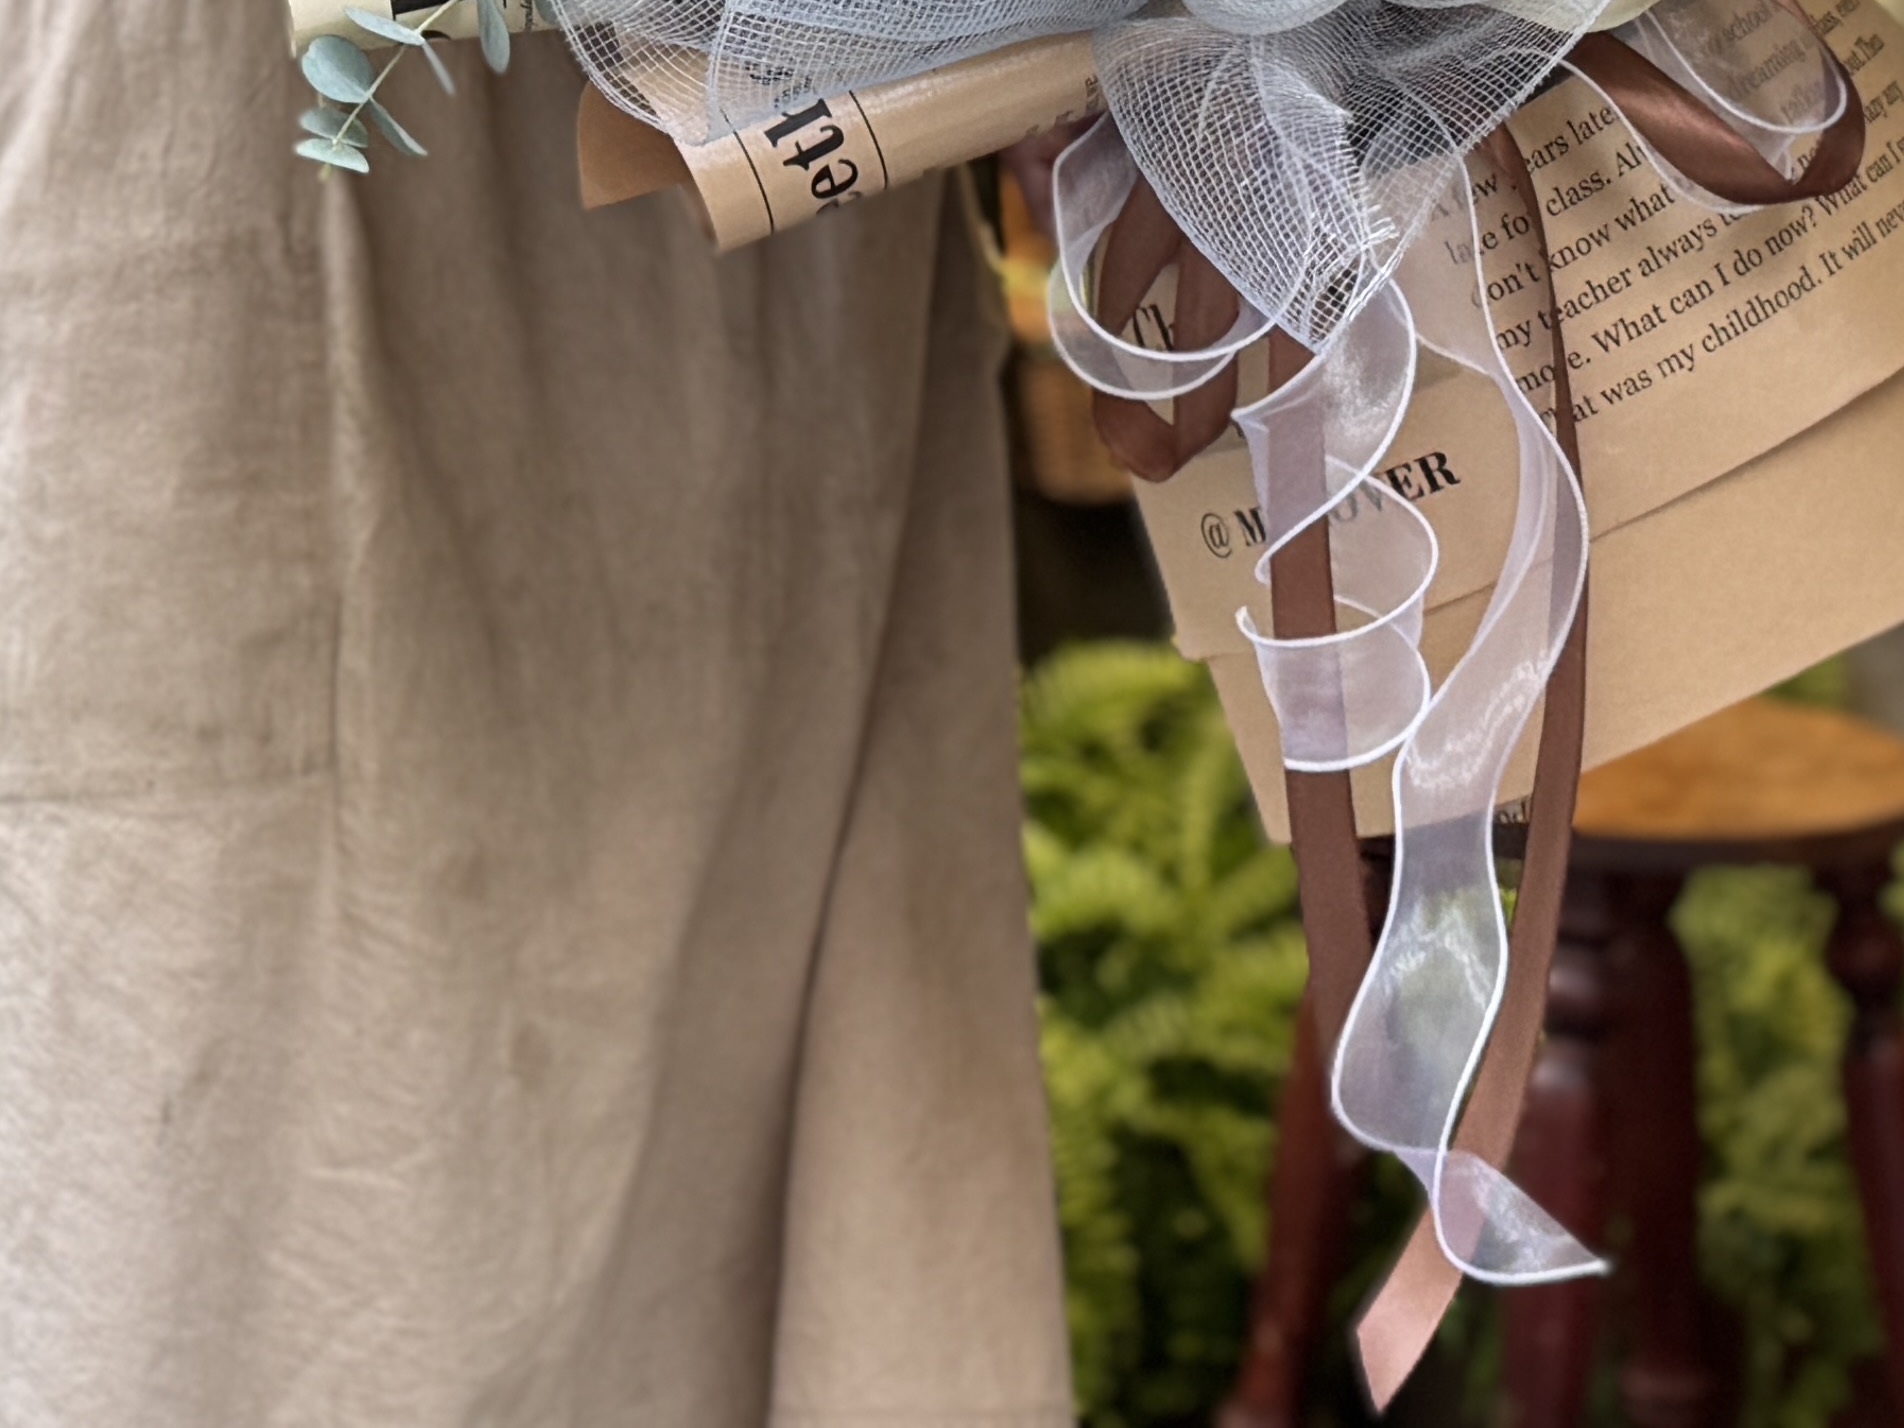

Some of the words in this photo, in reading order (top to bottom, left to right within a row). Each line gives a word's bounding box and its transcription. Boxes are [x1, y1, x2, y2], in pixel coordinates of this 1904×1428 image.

[1511, 140, 1570, 180] ears
[1568, 106, 1618, 143] late
[1447, 229, 1500, 263] lae
[1502, 211, 1529, 241] fo
[1545, 173, 1611, 218] class.
[1615, 189, 1673, 234] what
[1495, 318, 1537, 356] my
[1637, 220, 1717, 277] always
[1516, 349, 1590, 395] moe.
[1590, 306, 1665, 354] What
[1670, 282, 1714, 316] can
[1715, 263, 1731, 287] I
[1729, 245, 1765, 277] do
[1764, 209, 1822, 257] now?
[1867, 157, 1895, 184] can
[1602, 371, 1654, 406] was
[1656, 345, 1698, 381] my
[1702, 266, 1824, 354] childhood.
[1820, 248, 1843, 277] It
[1840, 220, 1877, 260] will
[1201, 513, 1233, 558] @
